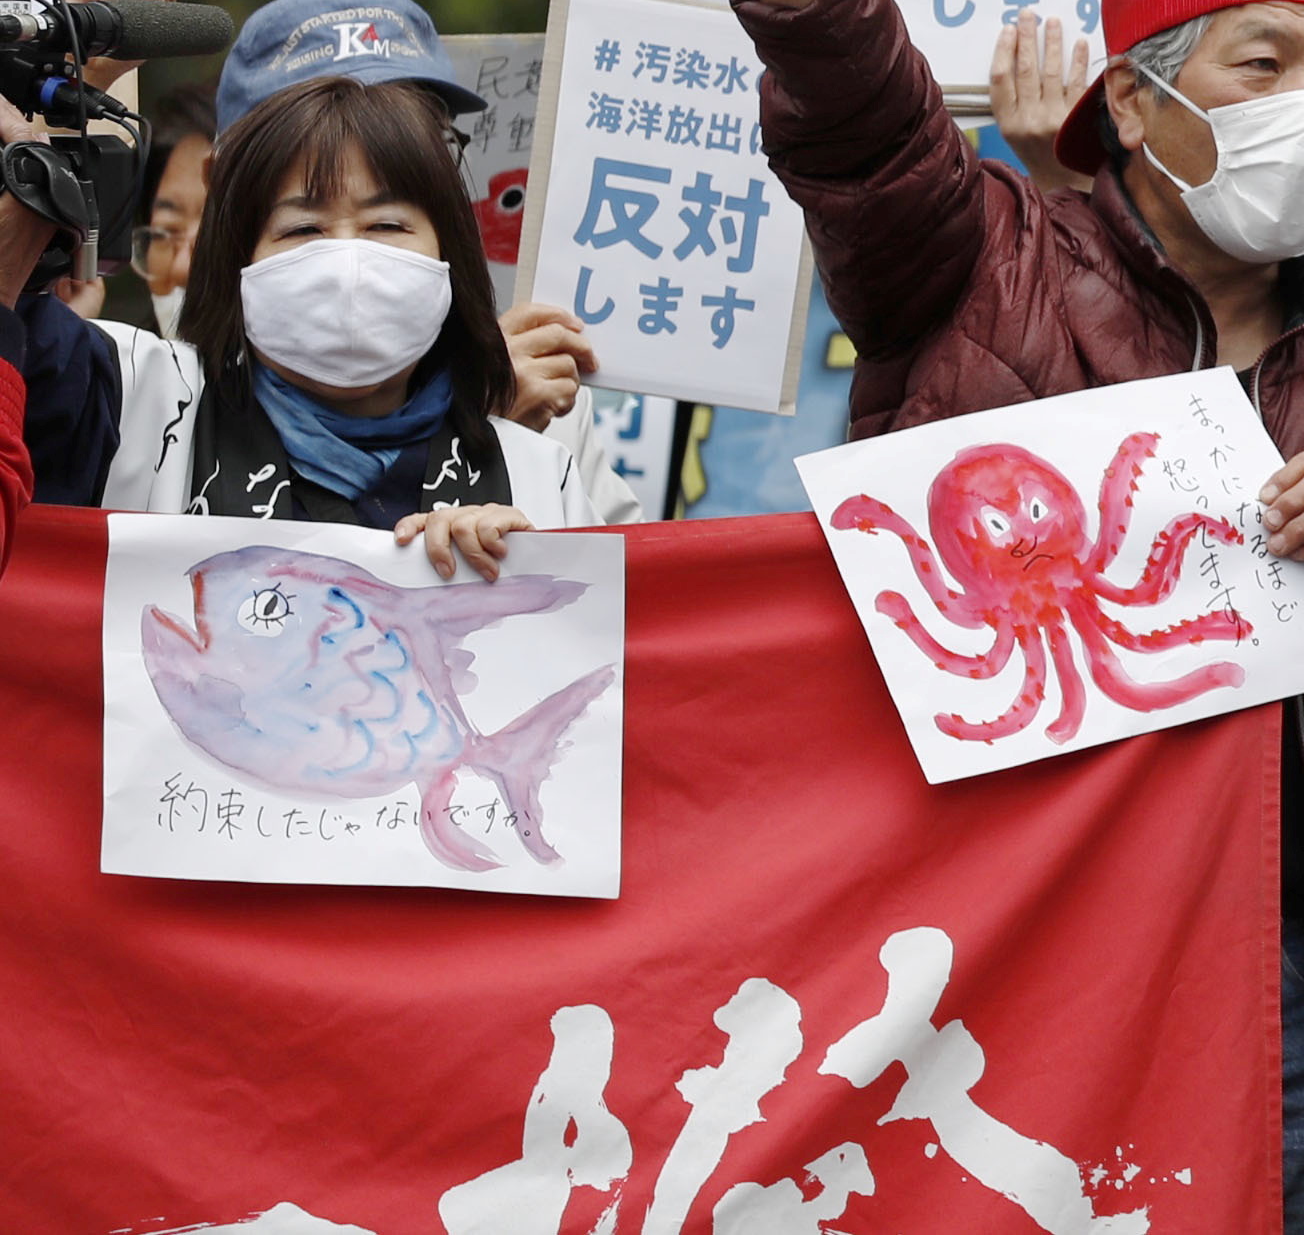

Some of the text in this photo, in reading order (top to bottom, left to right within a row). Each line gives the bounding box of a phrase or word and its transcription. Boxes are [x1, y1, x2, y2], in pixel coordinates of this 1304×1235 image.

[594, 40, 765, 94] #汚染水
[573, 157, 770, 273] 反対
[574, 266, 756, 349] します
